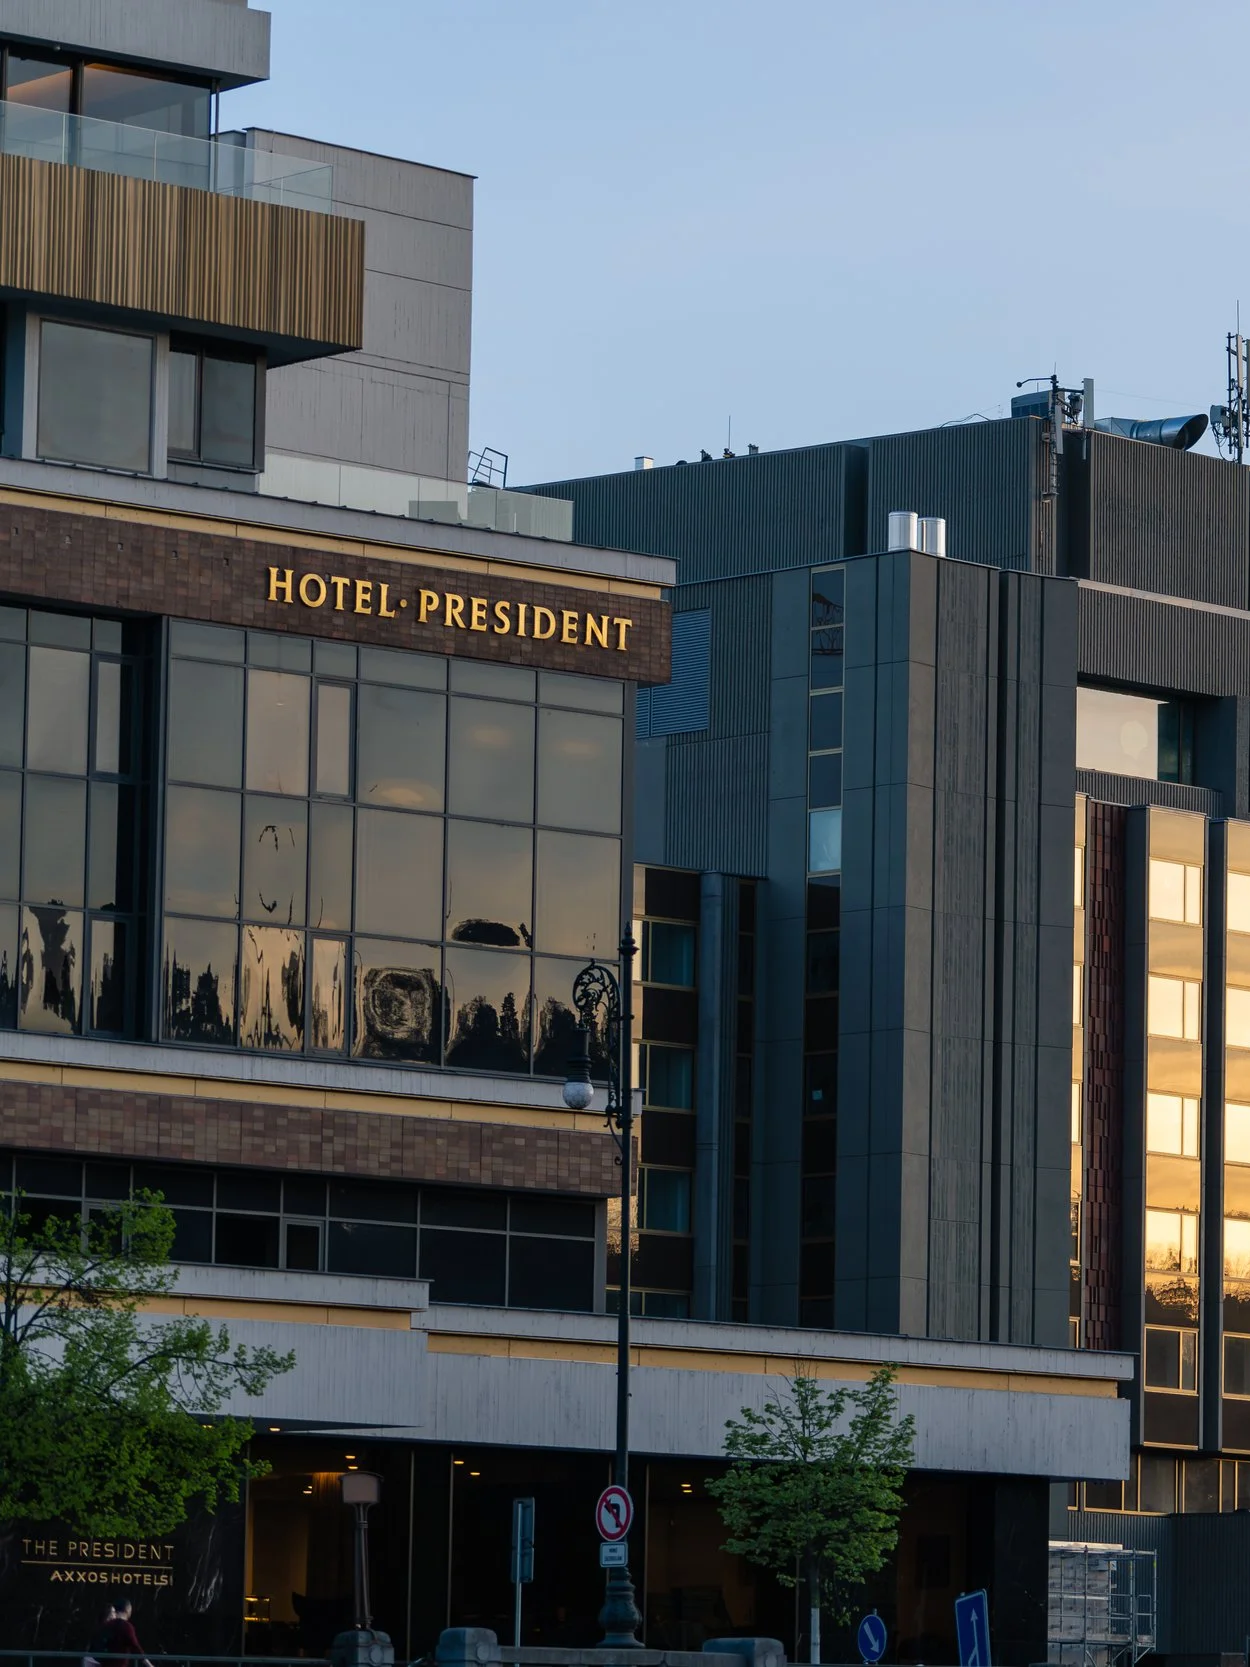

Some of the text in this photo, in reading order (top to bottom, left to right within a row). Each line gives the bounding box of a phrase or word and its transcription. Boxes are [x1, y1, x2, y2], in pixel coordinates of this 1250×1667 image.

[268, 567, 633, 651] HOTEL PRESIDENT
[22, 1538, 175, 1561] THE PRESIDENT
